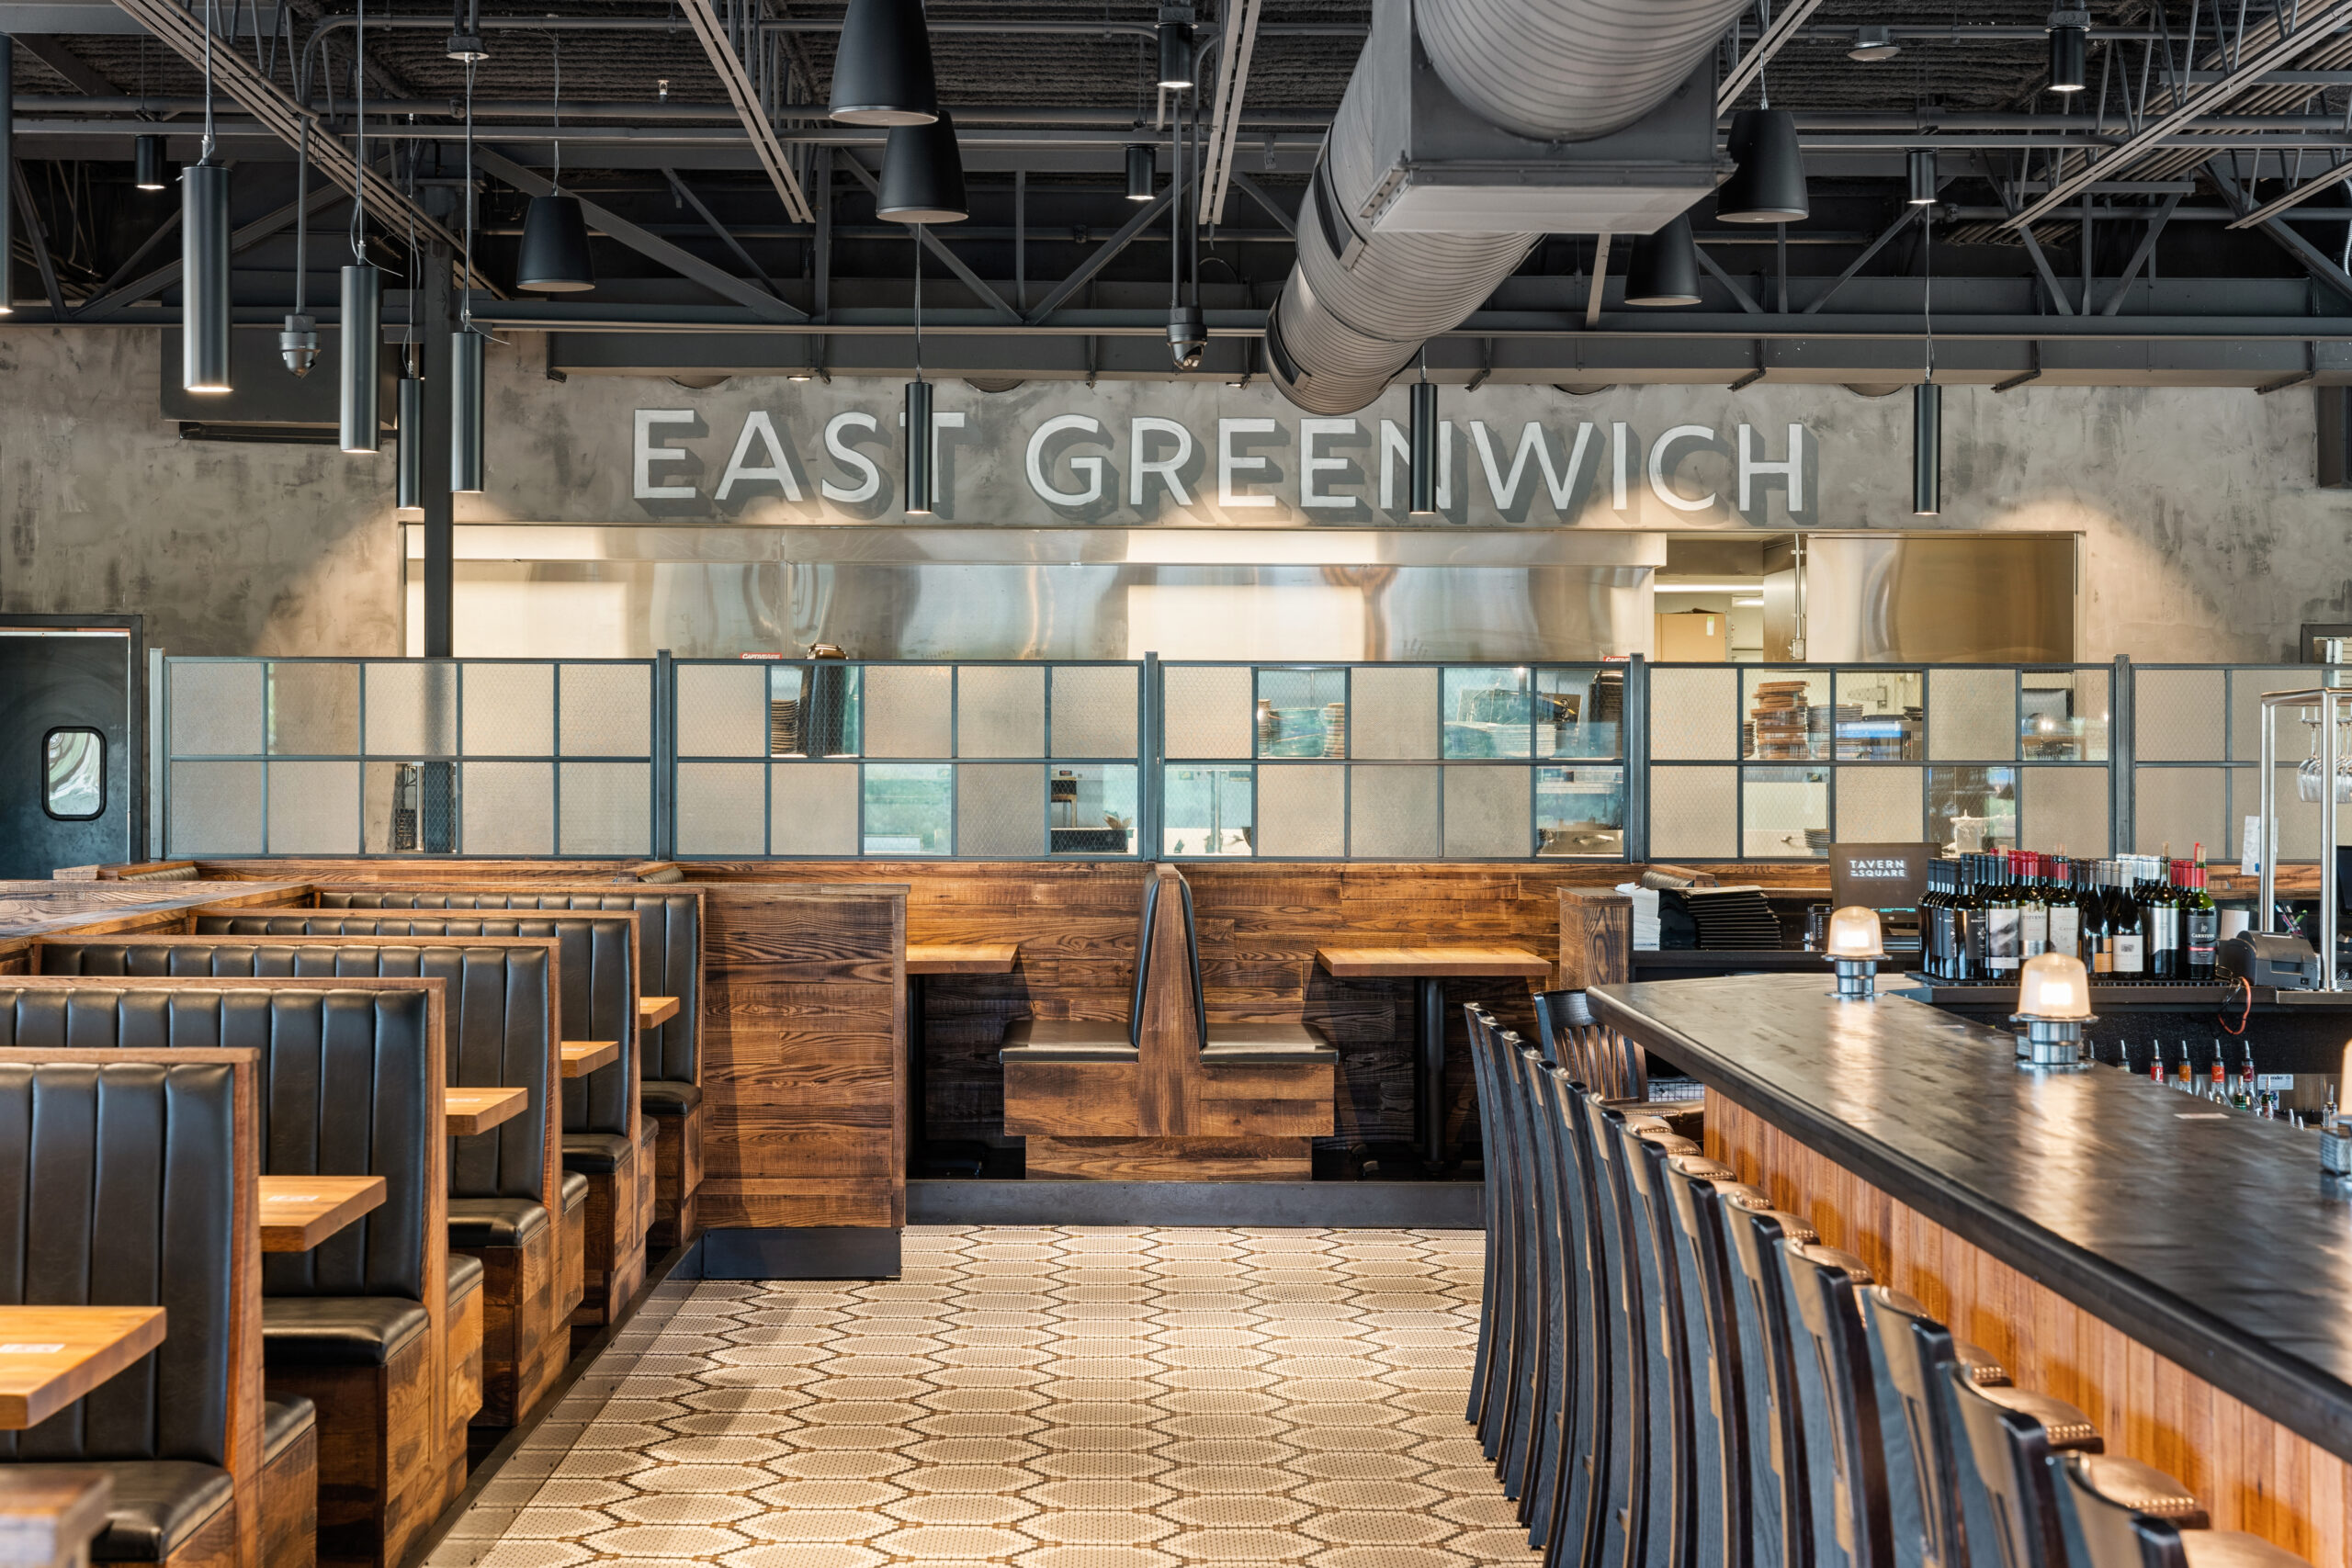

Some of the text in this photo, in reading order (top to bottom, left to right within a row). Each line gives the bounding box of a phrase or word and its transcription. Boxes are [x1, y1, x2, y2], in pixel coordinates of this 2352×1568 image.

[634, 409, 1803, 512] EAST GREENWICH
[1849, 860, 1905, 869] TAVERN
[1859, 869, 1905, 877] SQUARE
